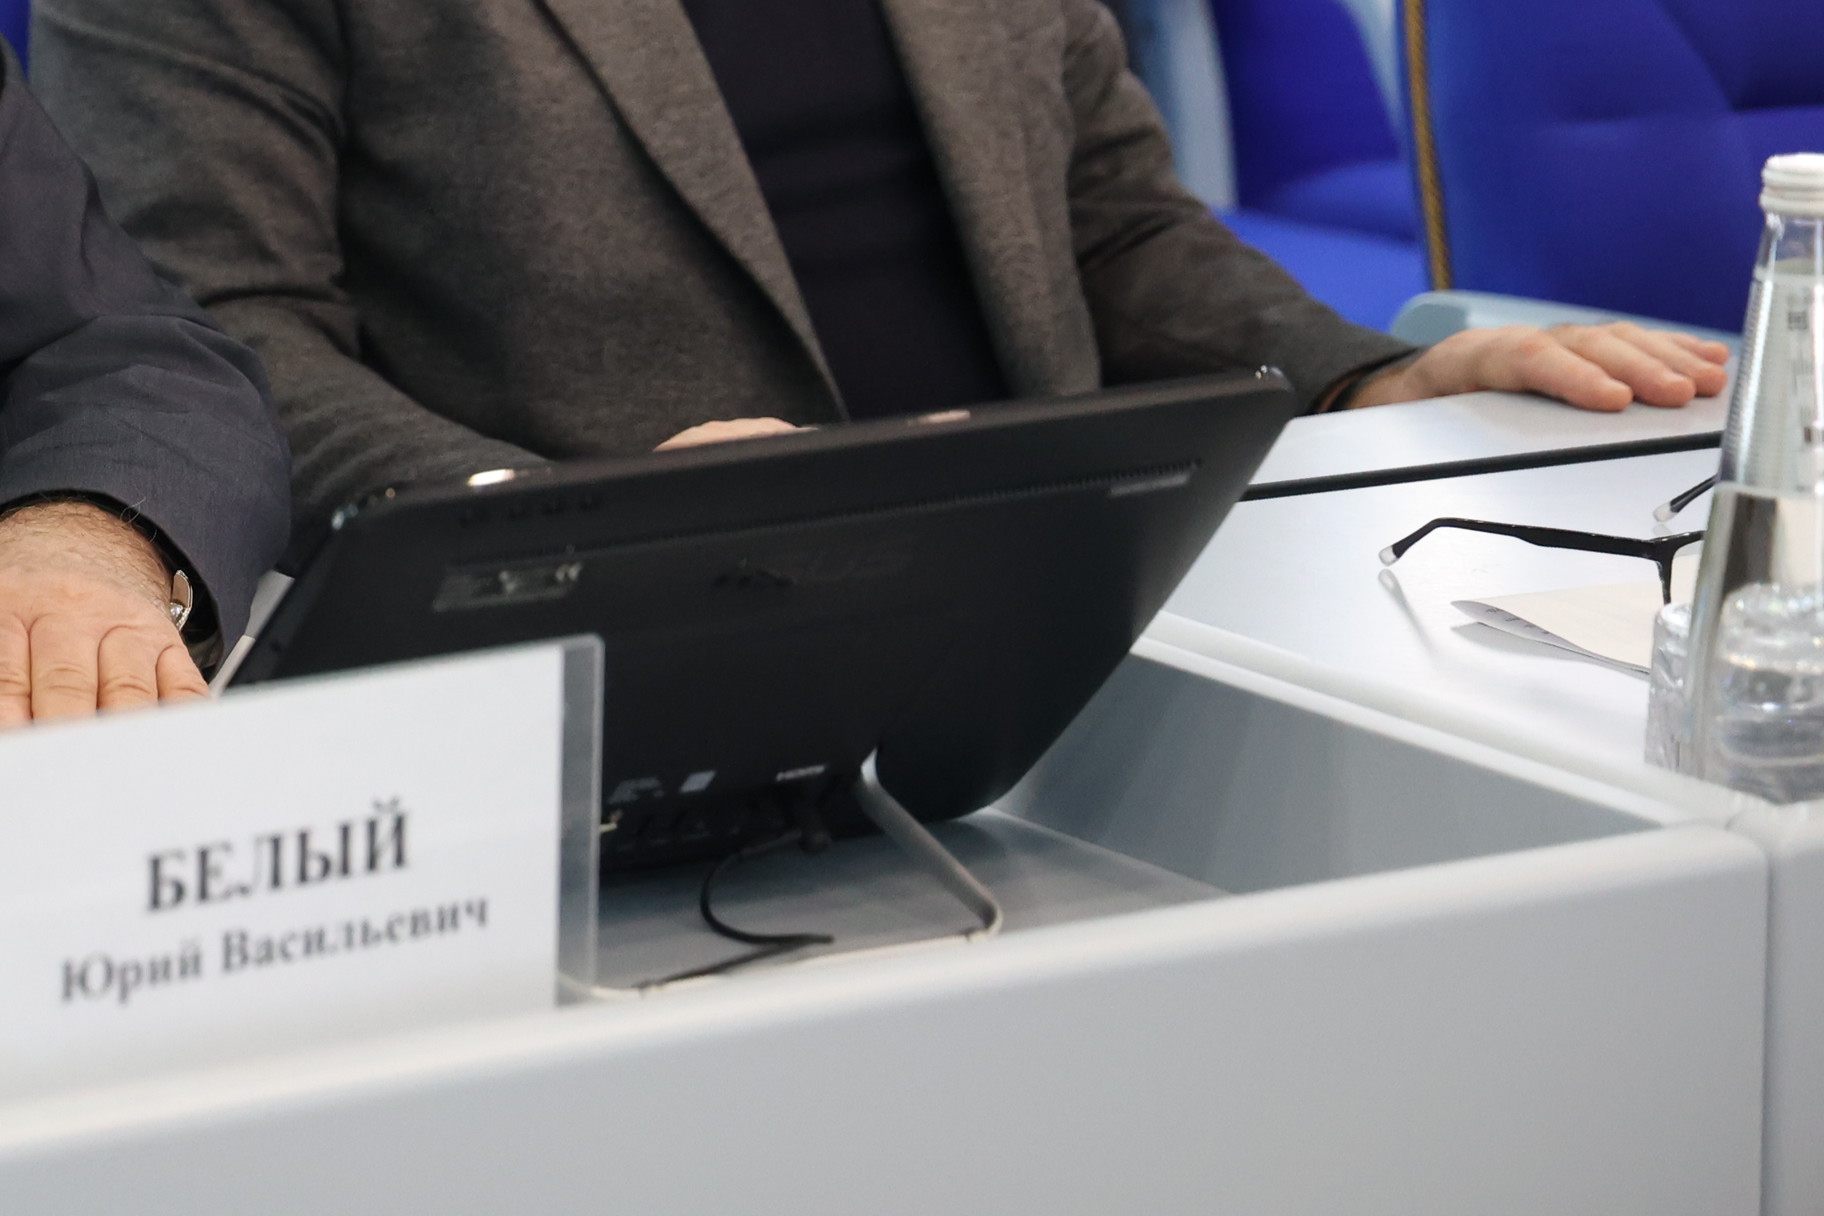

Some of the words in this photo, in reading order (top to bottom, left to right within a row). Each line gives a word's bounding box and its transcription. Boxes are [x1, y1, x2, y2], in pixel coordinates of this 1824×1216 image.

[147, 797, 409, 914] БЕЛЫЙ
[61, 946, 203, 1005] Юрий
[221, 898, 488, 974] Васильевич
